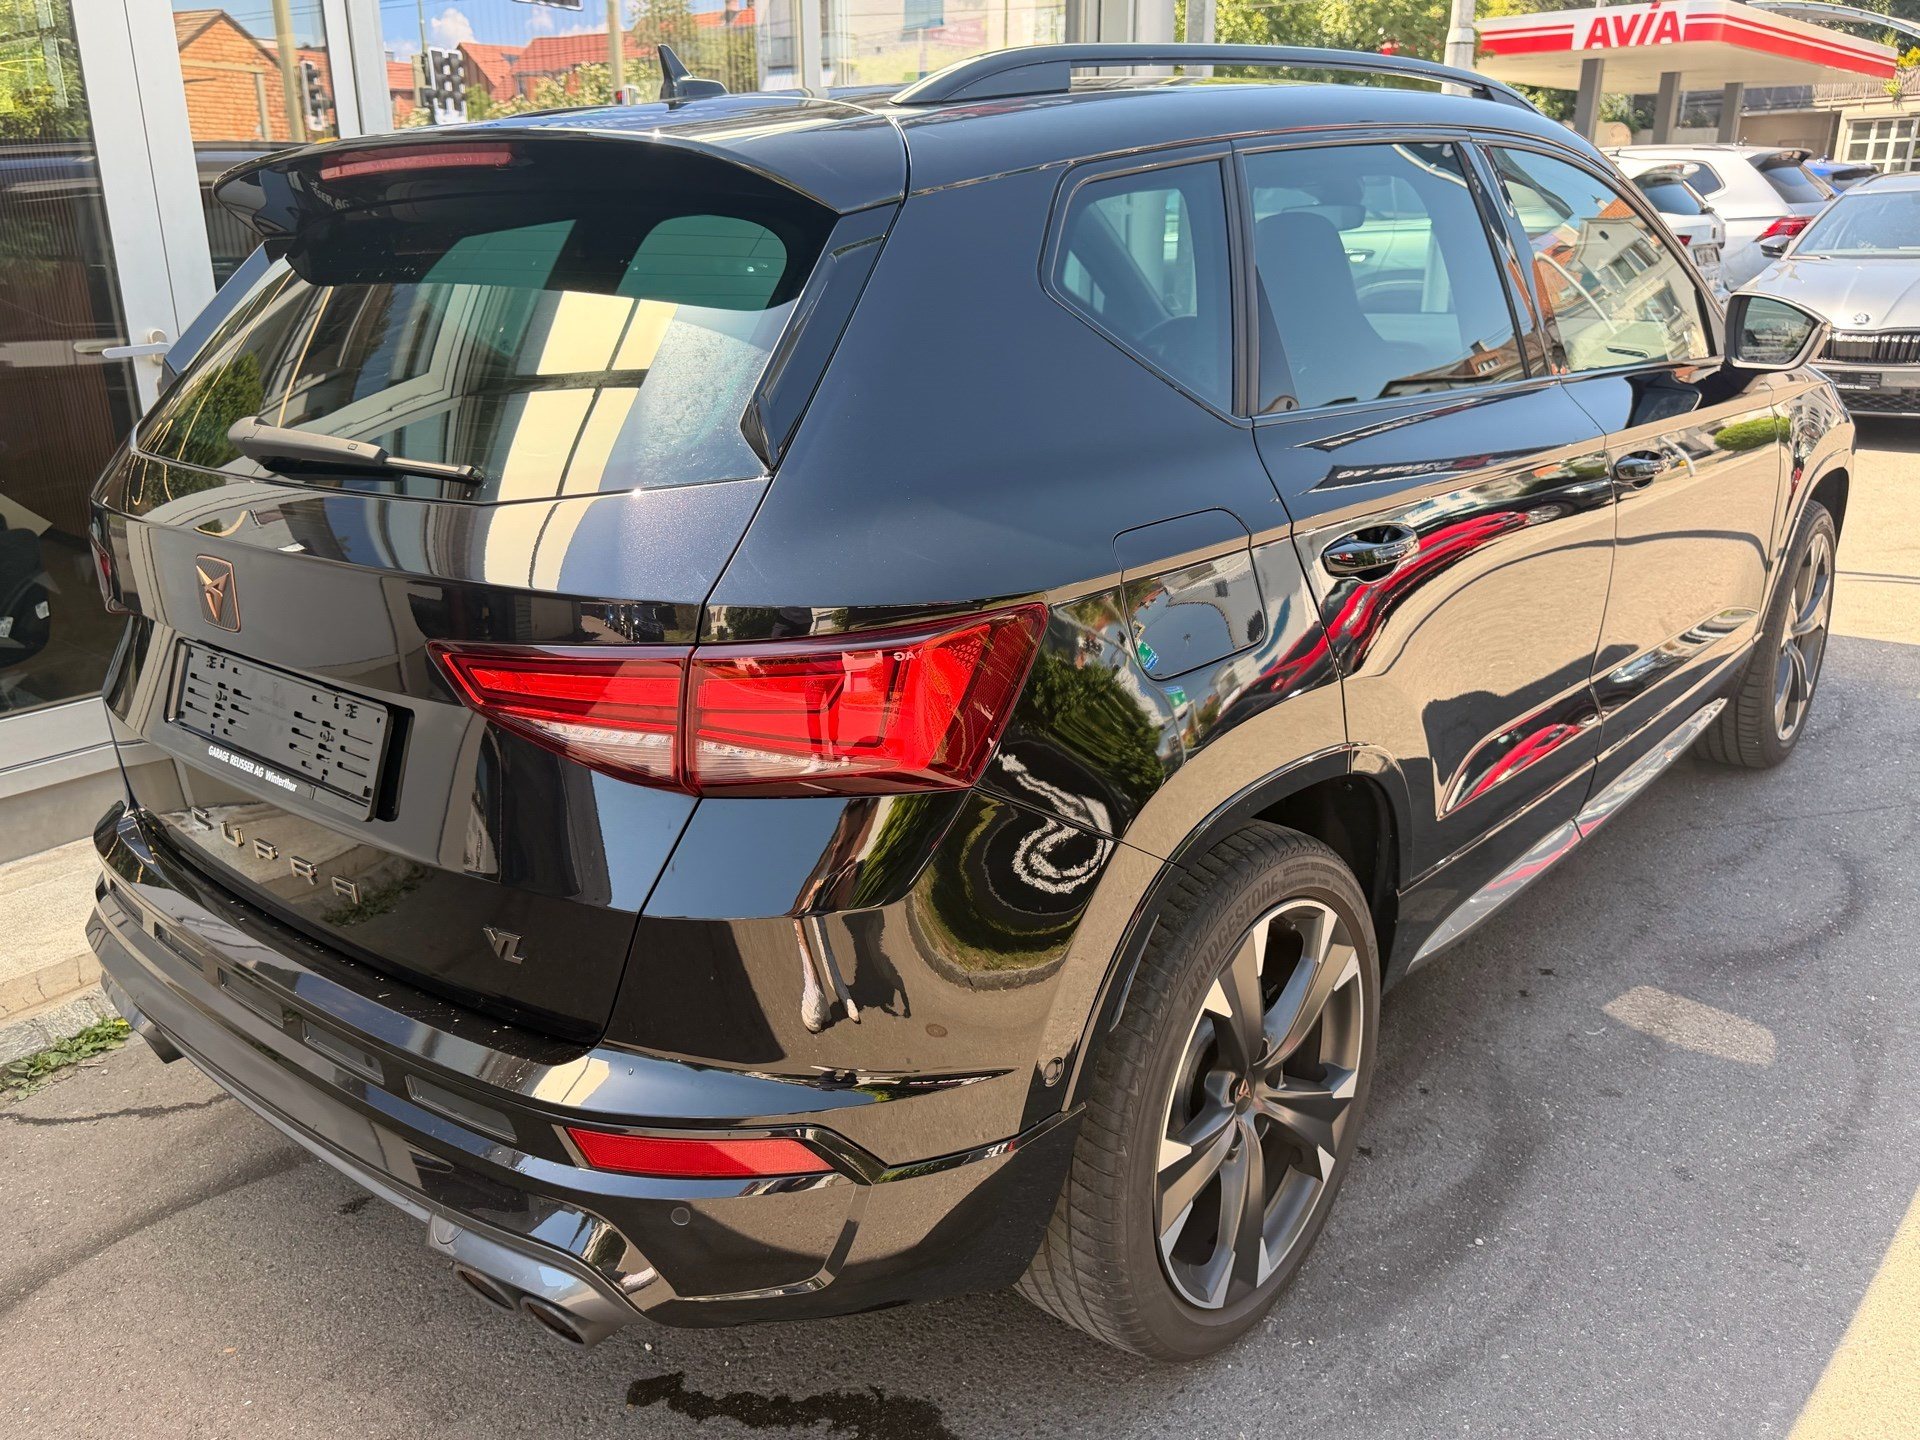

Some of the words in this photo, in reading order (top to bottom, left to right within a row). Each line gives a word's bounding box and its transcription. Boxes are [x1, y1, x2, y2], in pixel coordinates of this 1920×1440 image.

[1584, 2, 1680, 49] AVIA
[208, 745, 230, 763] GARAGE
[229, 754, 255, 774] REUSSER
[253, 765, 264, 778] AG
[265, 769, 298, 792] Winterthur
[191, 806, 361, 905] CUPRA
